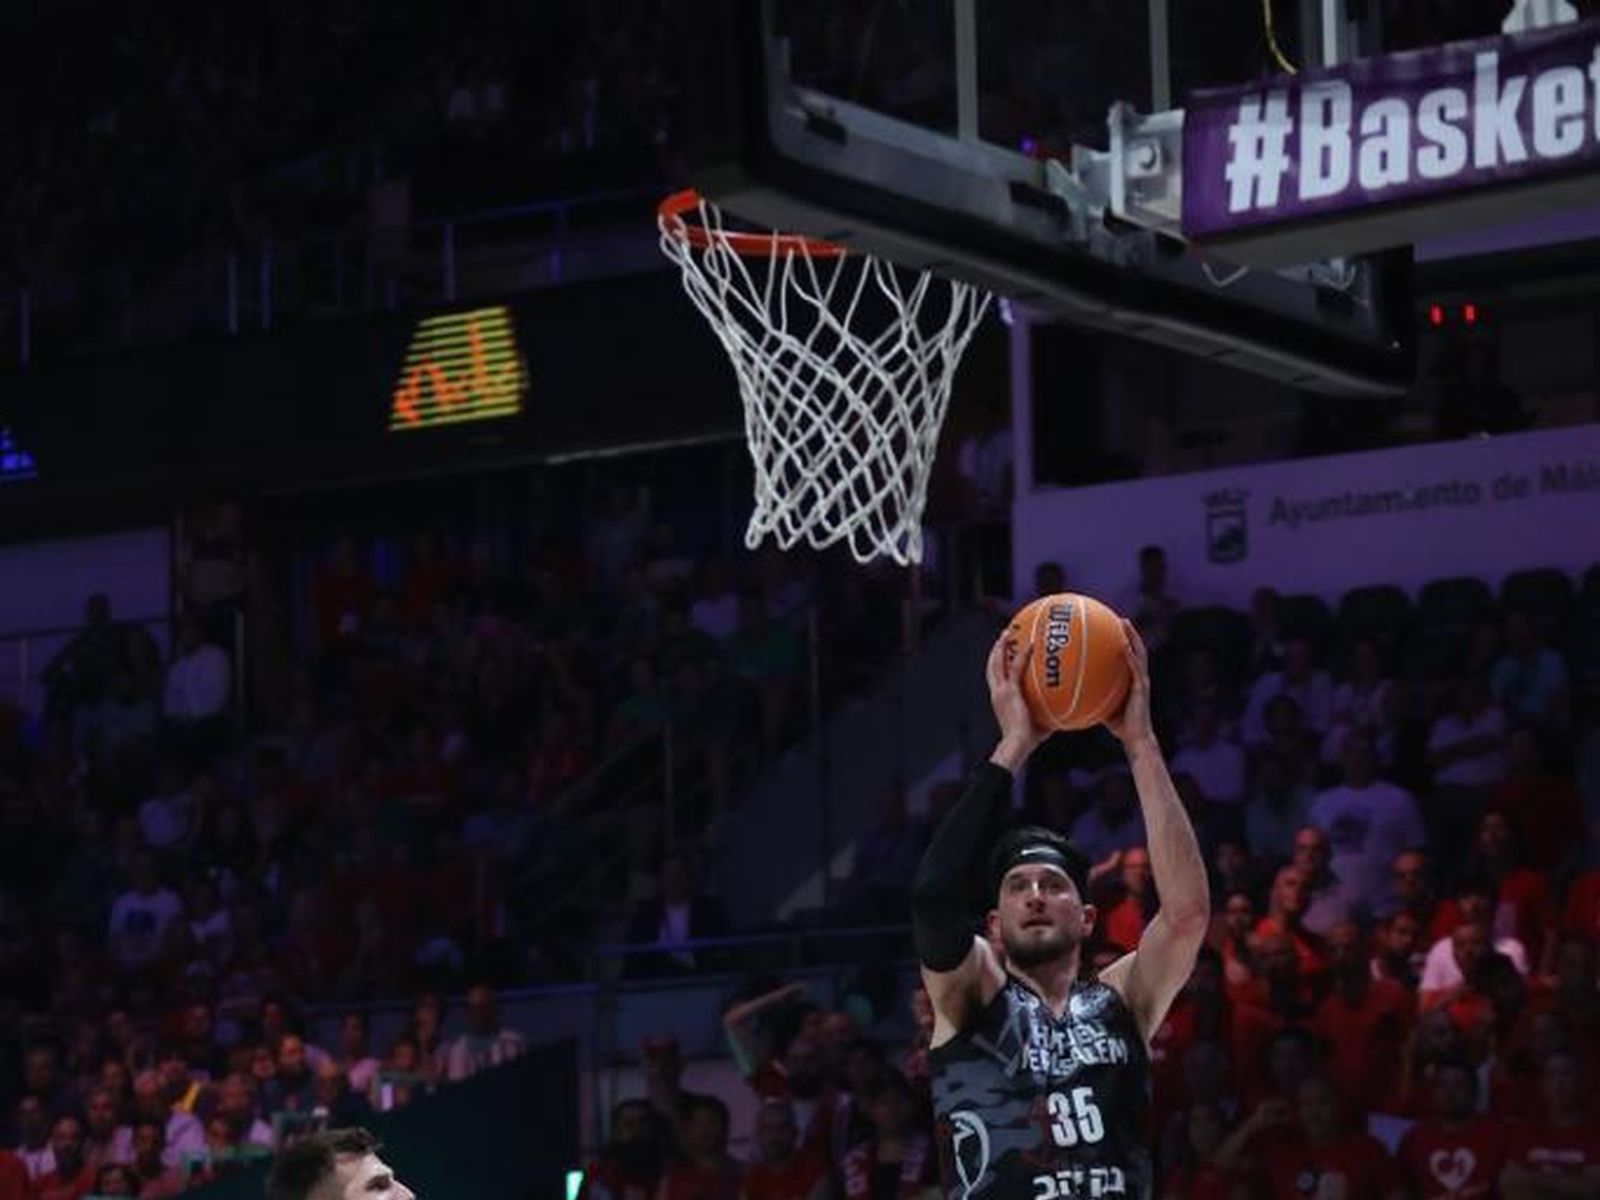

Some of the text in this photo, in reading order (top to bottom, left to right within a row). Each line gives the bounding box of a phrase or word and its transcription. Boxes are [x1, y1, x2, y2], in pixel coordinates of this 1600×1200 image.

[1491, 469, 1529, 500] de
[1046, 604, 1072, 687] Wilson
[1047, 1086, 1105, 1148] 35
